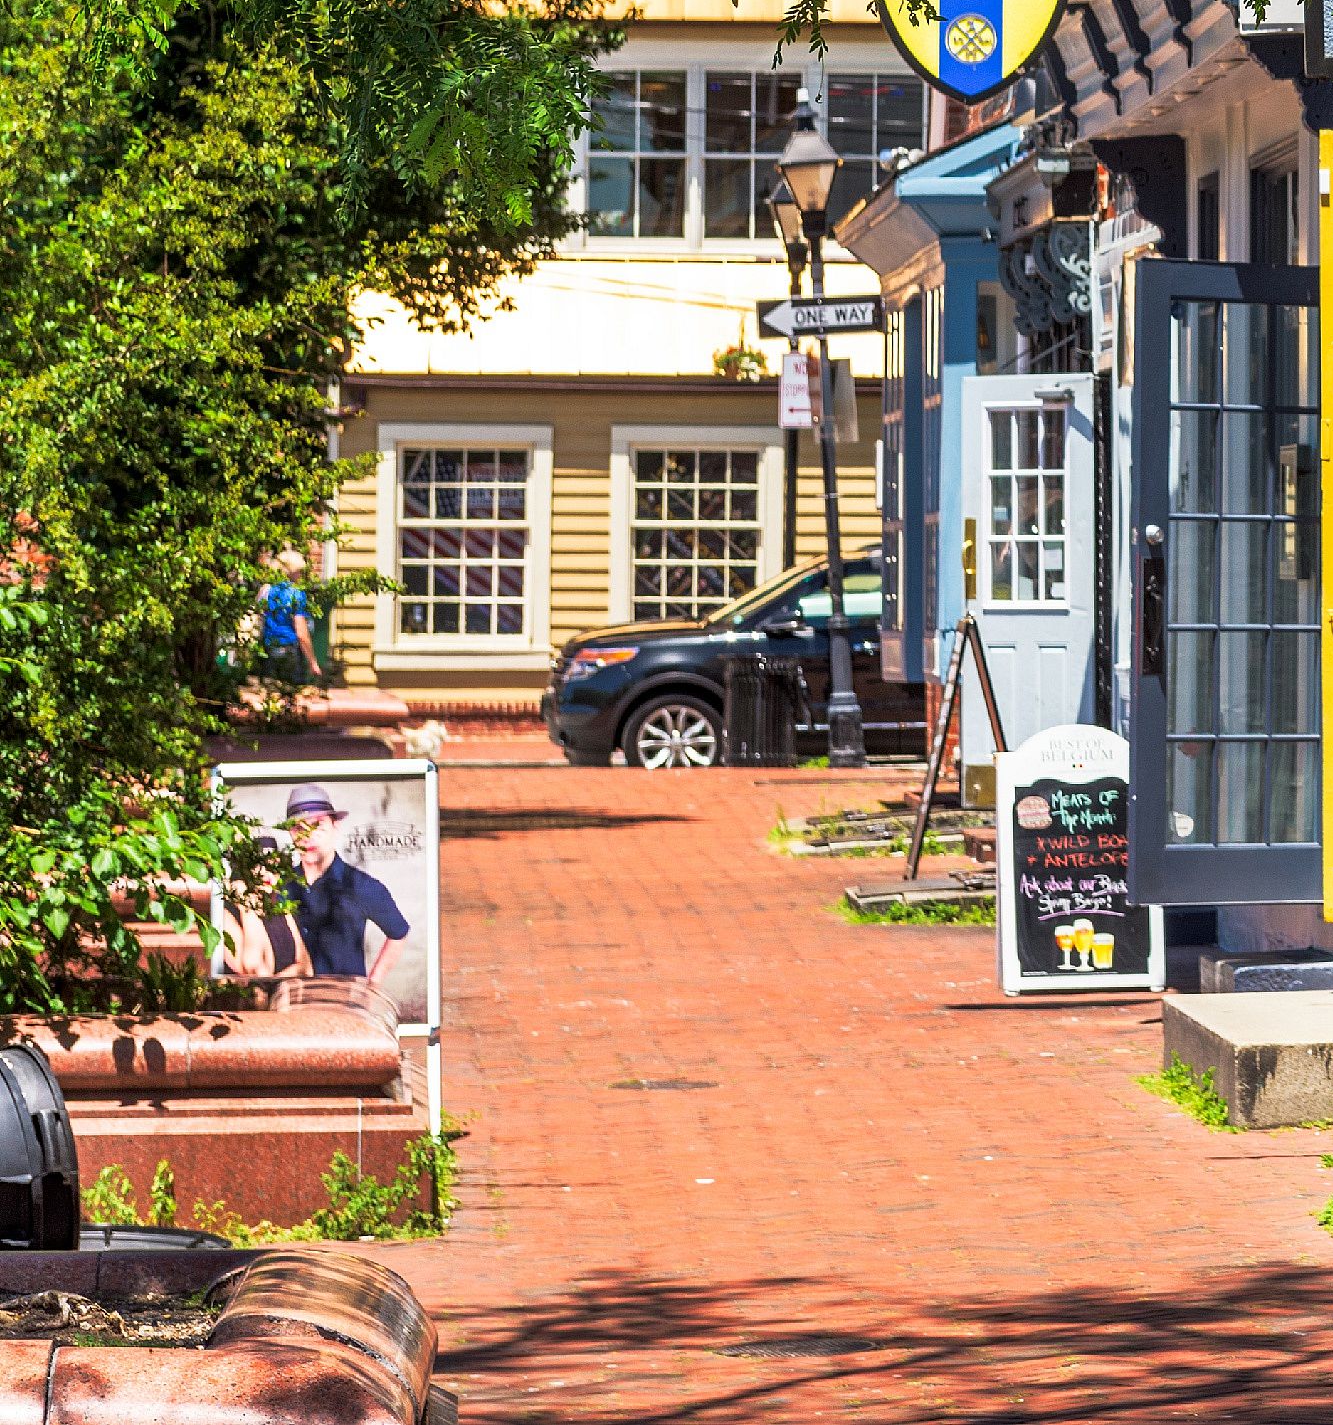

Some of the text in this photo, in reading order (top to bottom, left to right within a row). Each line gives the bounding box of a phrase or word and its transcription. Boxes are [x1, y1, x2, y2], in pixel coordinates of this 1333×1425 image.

[795, 306, 868, 325] ONE WAY
[348, 836, 417, 847] HANDMADE
[1097, 834, 1128, 849] BOA
